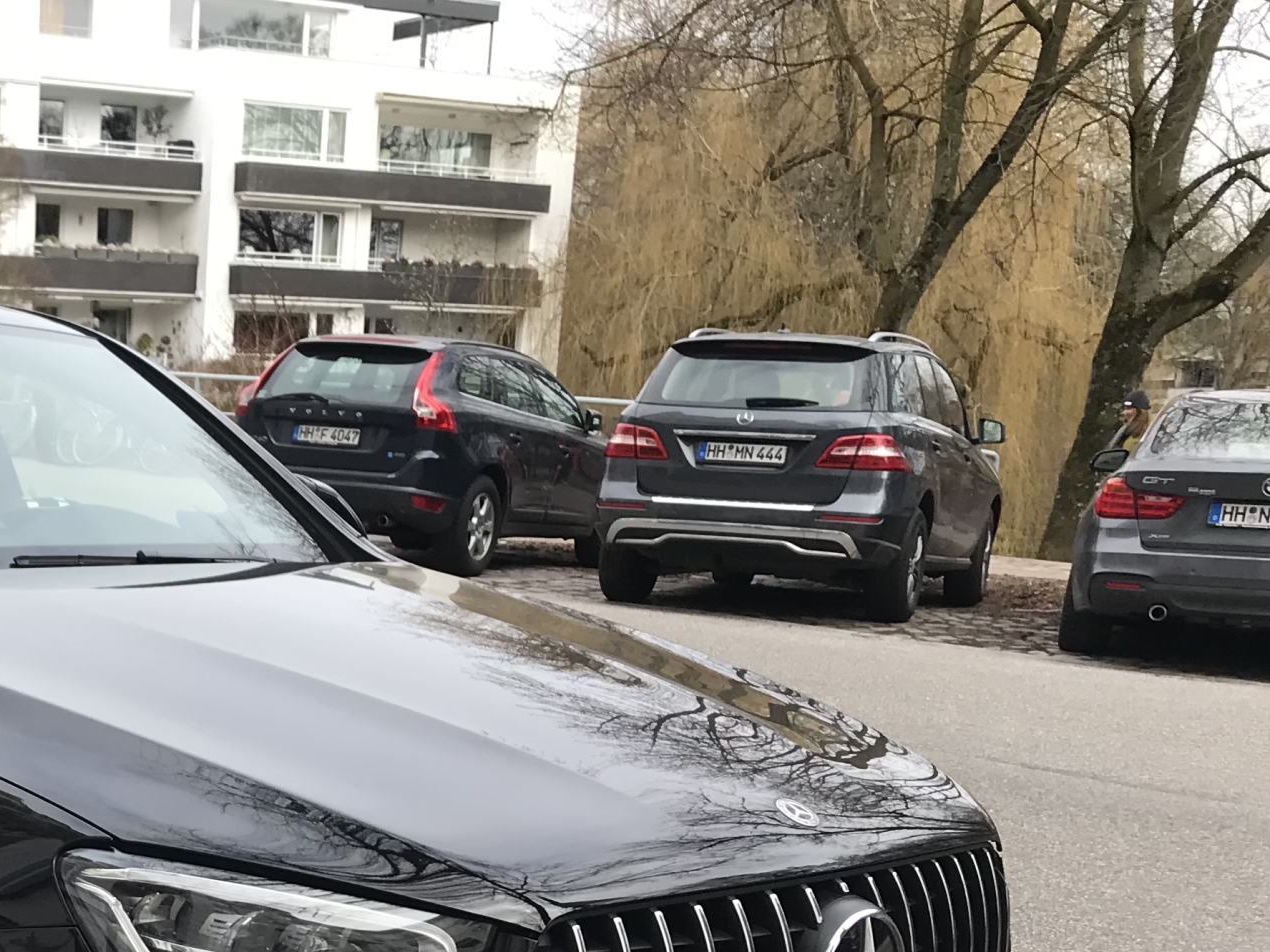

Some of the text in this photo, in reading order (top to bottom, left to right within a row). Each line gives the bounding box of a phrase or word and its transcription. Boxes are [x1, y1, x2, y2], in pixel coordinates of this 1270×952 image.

[299, 426, 315, 439] HH
[320, 428, 329, 440] F
[330, 428, 360, 443] 4047
[707, 443, 783, 461] HH MN 444
[1142, 476, 1175, 485] GT
[1221, 505, 1248, 523] HH
